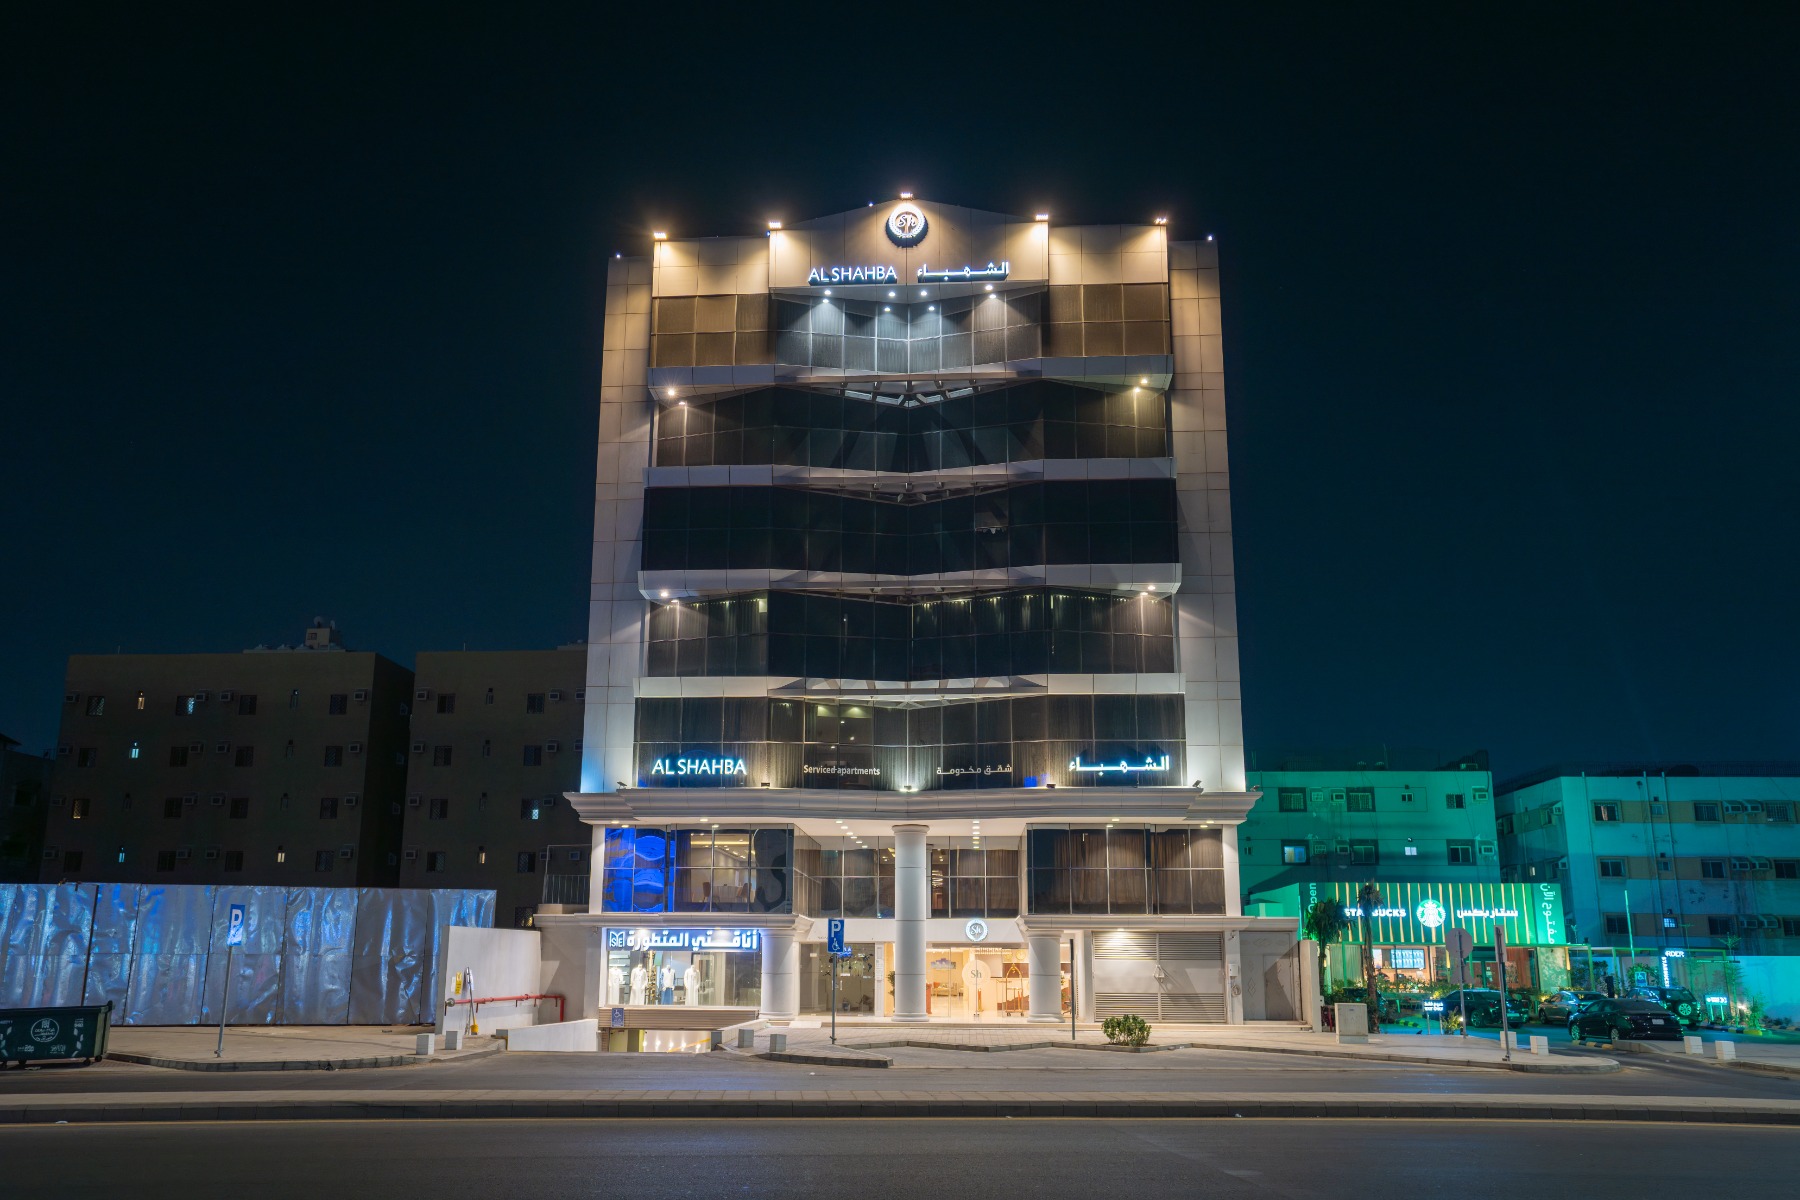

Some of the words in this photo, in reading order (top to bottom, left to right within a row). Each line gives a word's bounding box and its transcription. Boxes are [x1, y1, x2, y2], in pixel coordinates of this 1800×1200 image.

[809, 268, 829, 282] AL
[832, 266, 897, 282] SHAHBA
[651, 758, 675, 775] AL
[677, 758, 747, 775] SHAHBA
[803, 764, 836, 774] Serviced
[837, 765, 881, 776] apartments
[1344, 907, 1407, 918] STABUCKS
[830, 920, 842, 938] P
[970, 969, 982, 979] Sh
